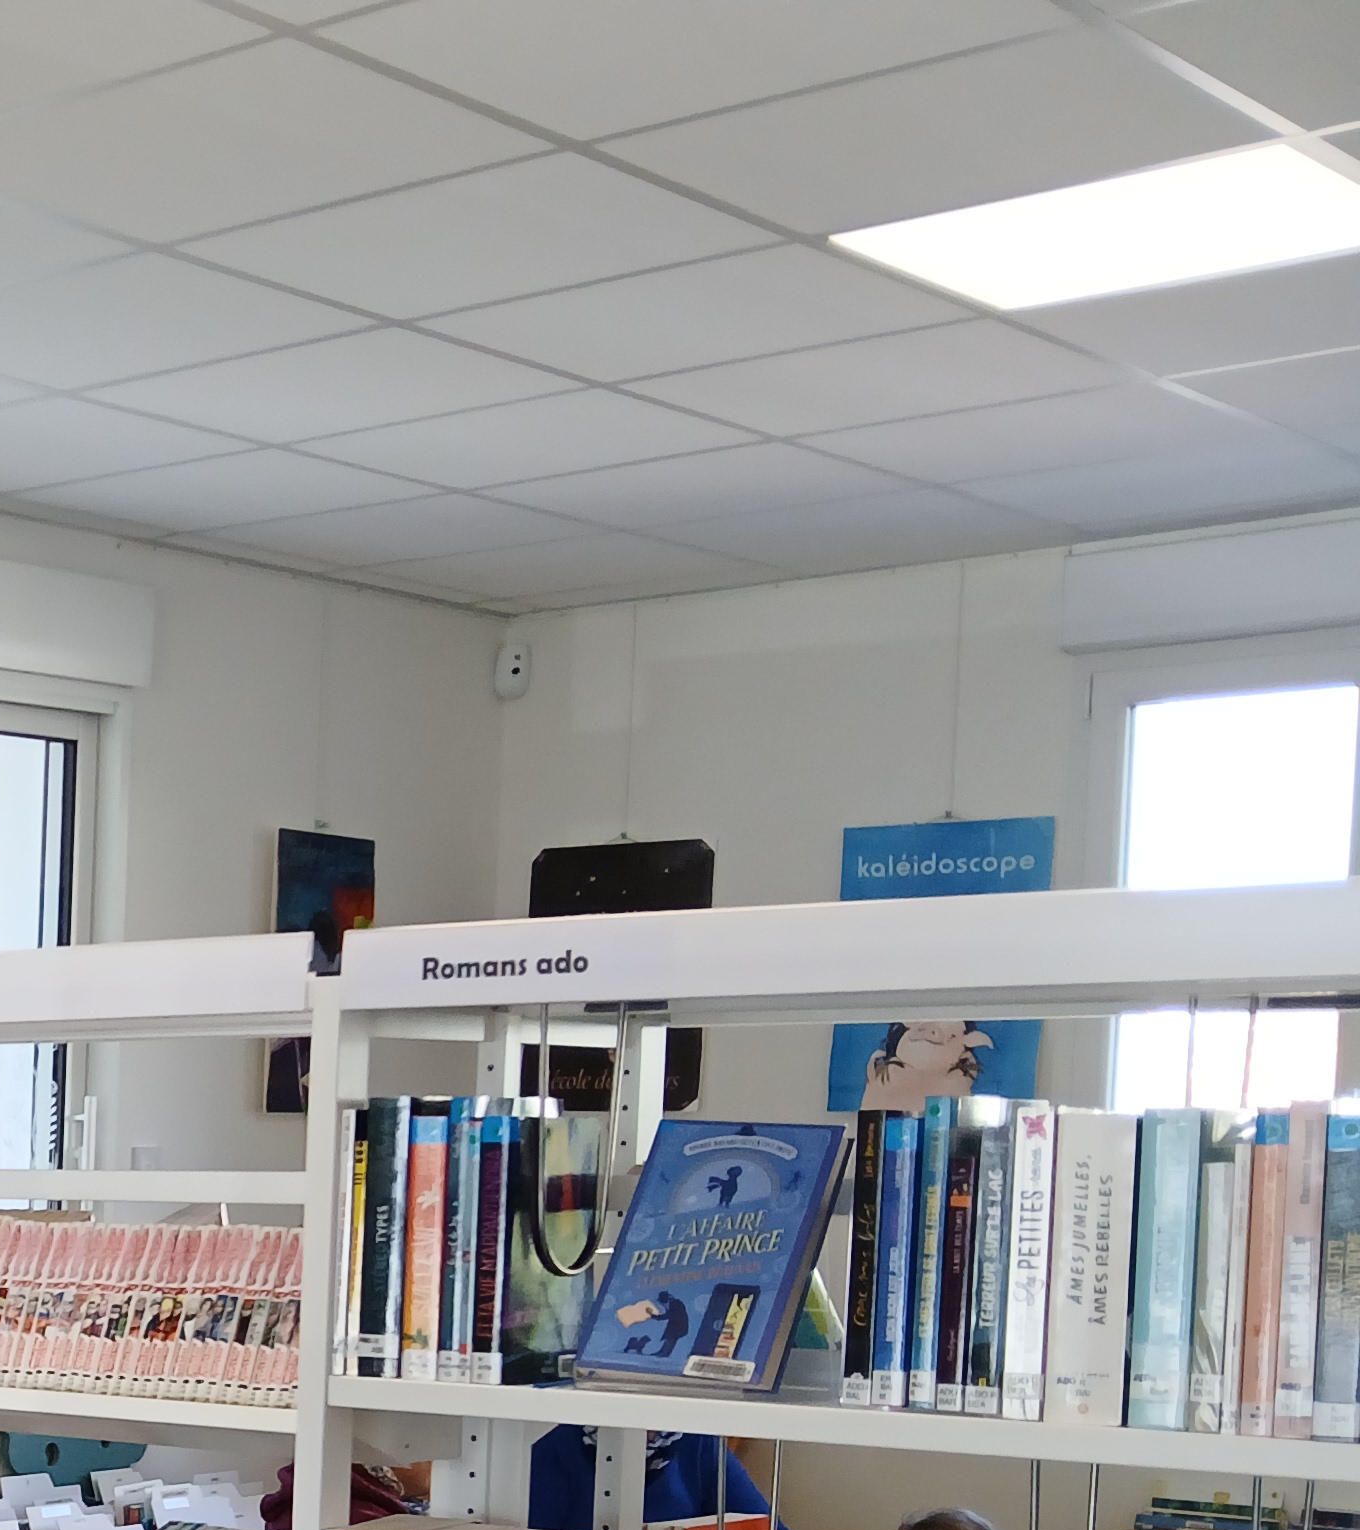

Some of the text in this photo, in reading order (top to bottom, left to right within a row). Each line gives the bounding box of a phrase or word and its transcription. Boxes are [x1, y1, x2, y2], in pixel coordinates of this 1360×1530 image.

[856, 849, 1036, 880] kaléidoscope
[422, 950, 589, 981] Romans ado
[628, 1244, 692, 1276] PETIT
[700, 1228, 784, 1267] PRINCE
[979, 1169, 1003, 1328] TERREUR LAC
[1017, 1190, 1044, 1270] PETITES
[1088, 1174, 1113, 1325] ÂMES REBELLES
